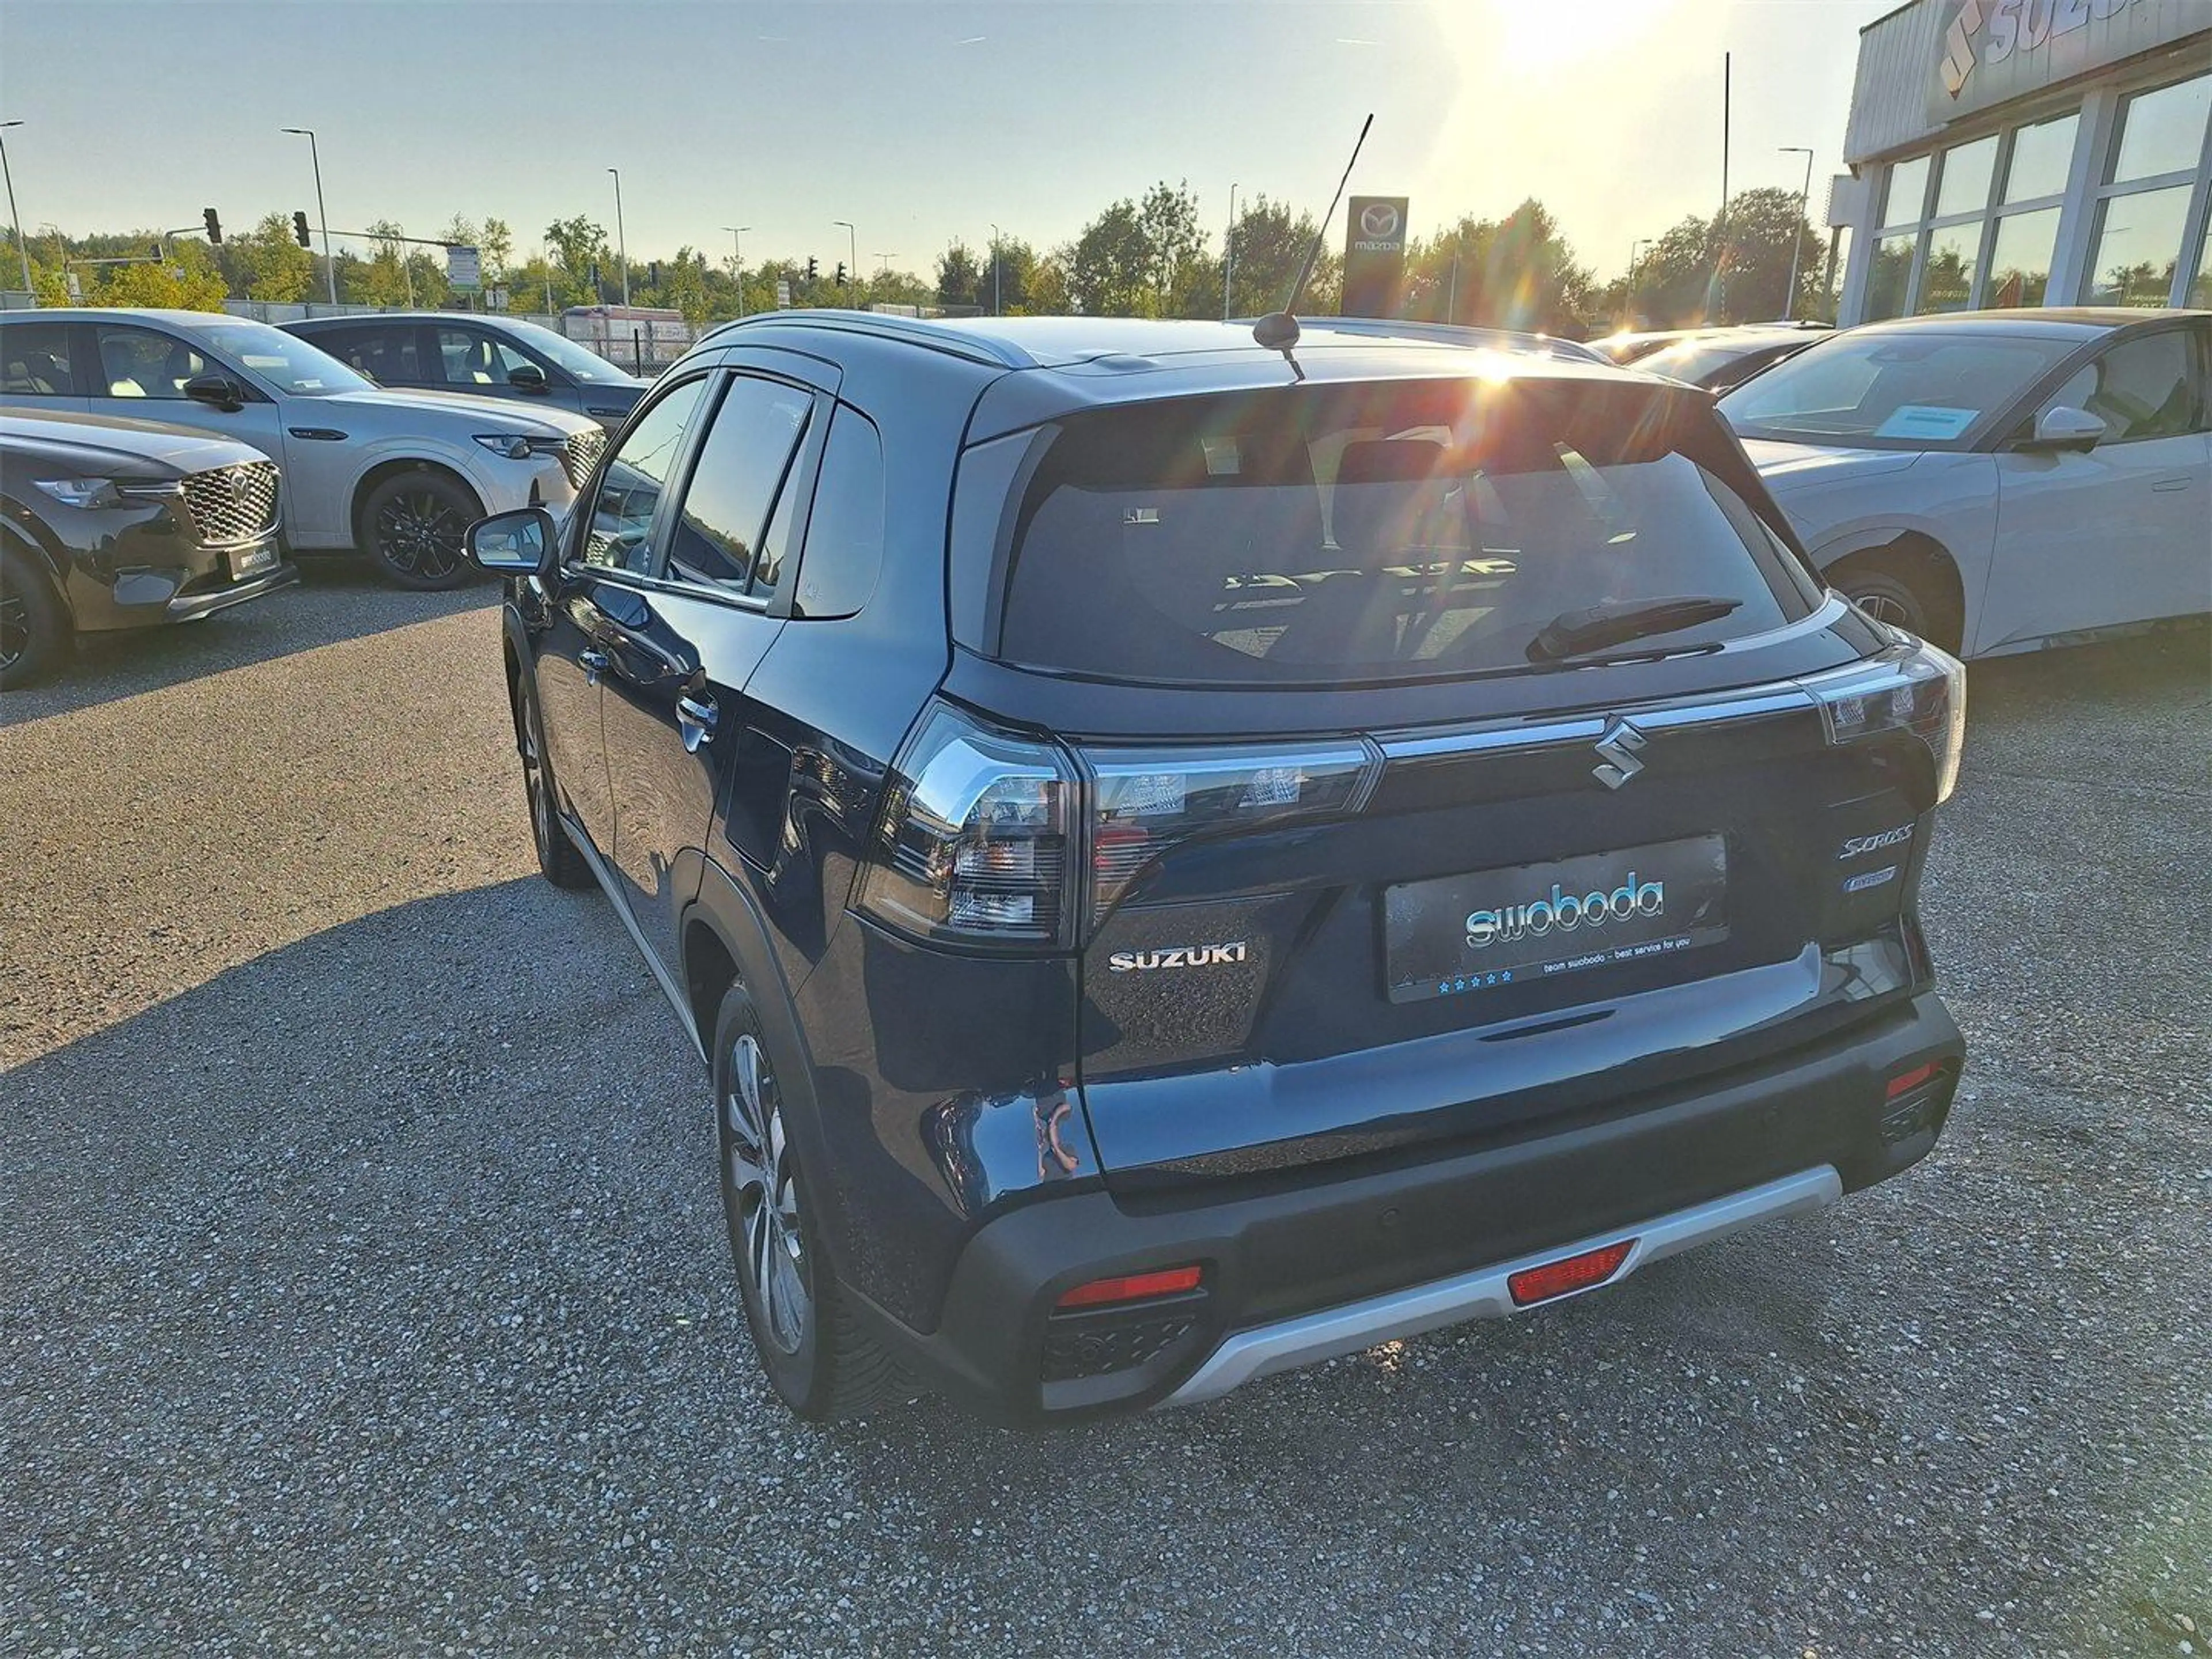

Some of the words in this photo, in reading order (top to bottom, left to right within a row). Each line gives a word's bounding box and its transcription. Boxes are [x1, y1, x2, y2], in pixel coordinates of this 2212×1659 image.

[1984, 0, 2144, 65] SUZ
[1355, 241, 1400, 251] mazda
[1465, 872, 1664, 949] swoboda
[1108, 941, 1246, 973] SUZUKI
[1543, 963, 1566, 974] team
[1567, 953, 1605, 969] swoboda
[1614, 948, 1633, 960] best
[1634, 942, 1662, 956] service
[1663, 939, 1674, 950] for
[1675, 937, 1692, 949] you
